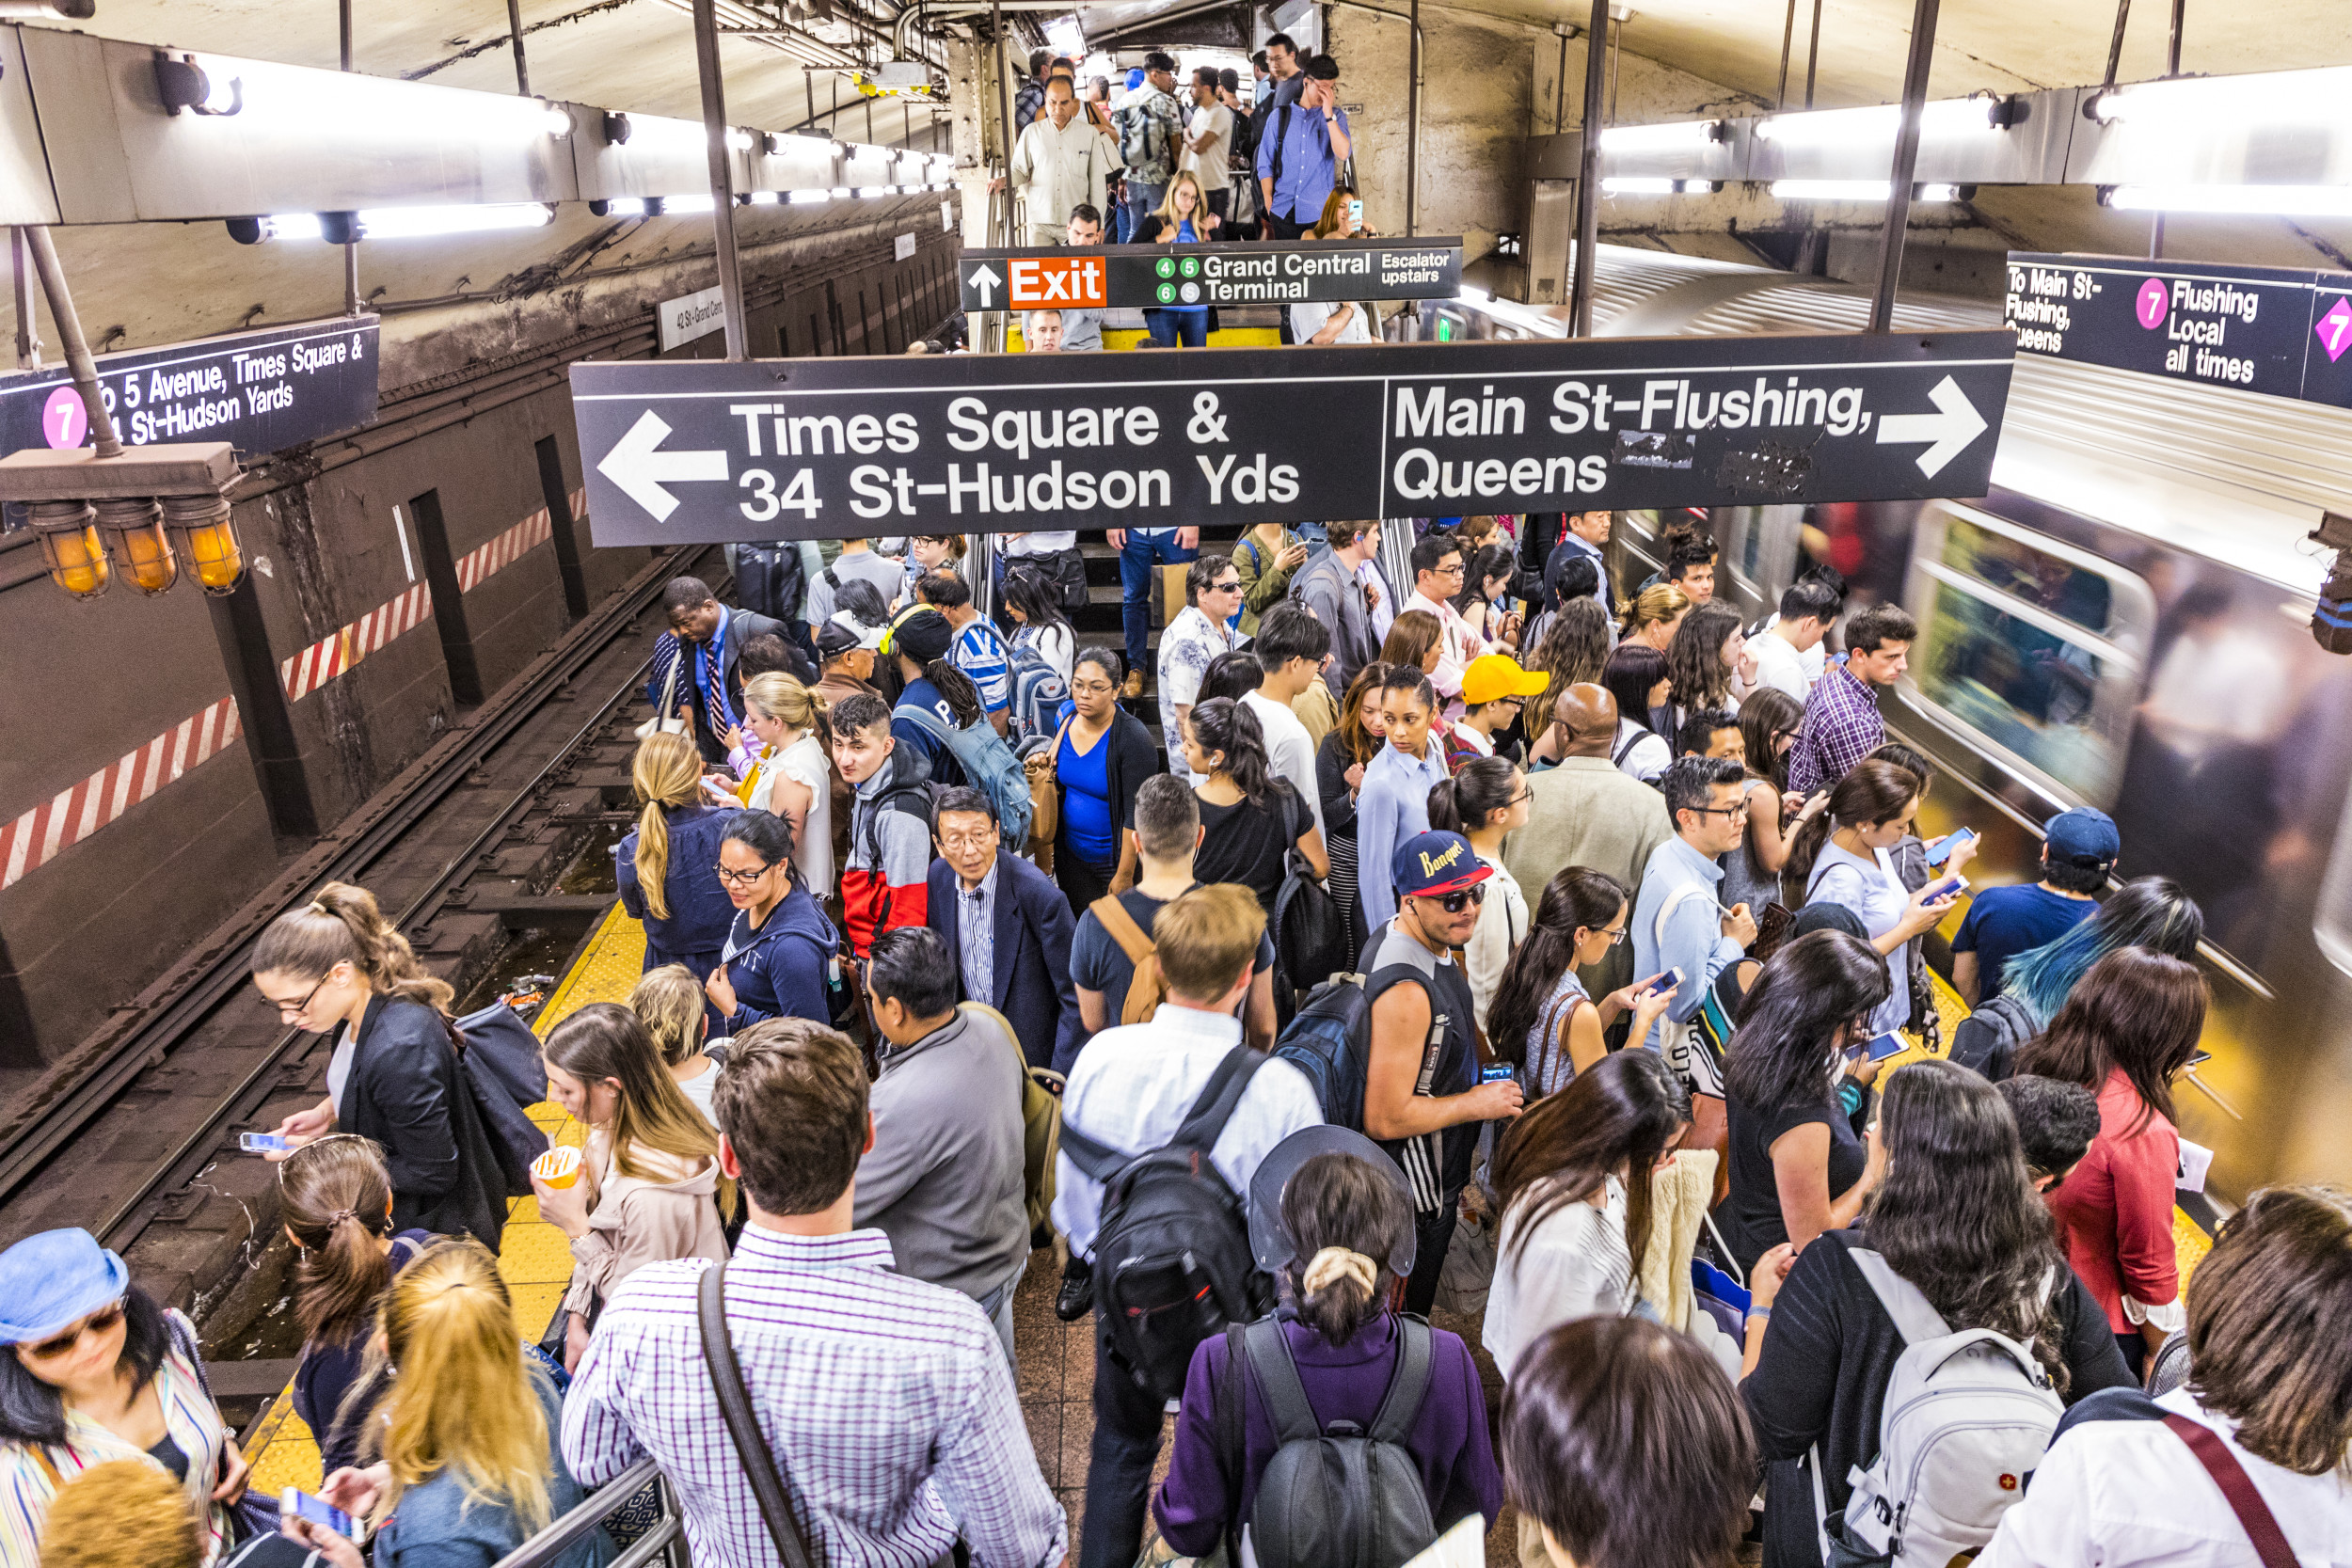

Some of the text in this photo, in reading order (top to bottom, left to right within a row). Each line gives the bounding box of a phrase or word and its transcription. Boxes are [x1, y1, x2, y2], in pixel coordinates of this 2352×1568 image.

[1161, 262, 1195, 275] 4 5
[1204, 252, 1371, 278] Grand Central
[1381, 252, 1450, 269] Escalator
[1381, 268, 1439, 287] upstairs
[1010, 261, 1101, 301] Exit
[1161, 286, 1196, 300] 6 S
[1205, 277, 1309, 300] Terminal
[2008, 266, 2103, 300] To Main St-
[677, 312, 685, 330] 42
[685, 309, 691, 327] St
[695, 303, 710, 323] Grand
[2005, 293, 2071, 331] Flushing,
[2148, 292, 2161, 320] 7
[2171, 280, 2259, 324] Flushing
[2169, 311, 2227, 346] Local
[2328, 314, 2350, 351] 7
[124, 373, 141, 408] 5
[149, 366, 227, 404] Avenue,
[231, 354, 285, 385] Times
[292, 341, 346, 374] Square
[352, 334, 363, 359] &
[2165, 344, 2254, 384] all times
[56, 403, 74, 442] 7
[132, 398, 240, 445] St-Hudson
[246, 380, 294, 415] Yards
[730, 390, 1230, 461] Times Square &
[1395, 377, 1872, 437] Main St-Flushing,
[739, 452, 1300, 522] 34 St-Hudson Yds
[1392, 448, 1607, 500] Queens
[1418, 839, 1465, 878] Banquet
